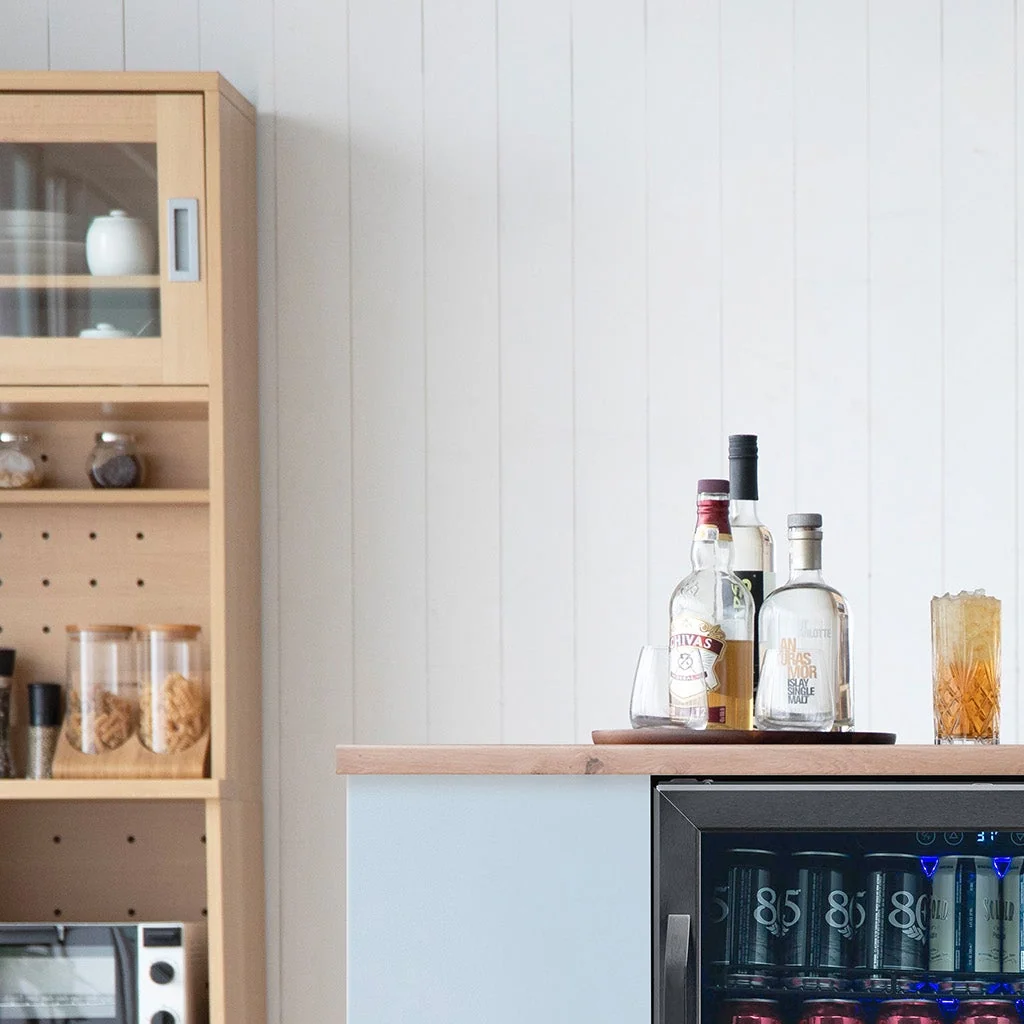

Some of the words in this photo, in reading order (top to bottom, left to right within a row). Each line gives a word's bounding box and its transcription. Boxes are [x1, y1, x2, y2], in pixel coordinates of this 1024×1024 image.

[670, 633, 713, 649] CHIVAS
[780, 637, 797, 652] AN
[778, 651, 812, 666] URAS
[787, 665, 817, 679] MOR
[788, 678, 809, 687] ISLAY
[788, 687, 815, 696] SINGLE
[788, 695, 809, 704] MALT
